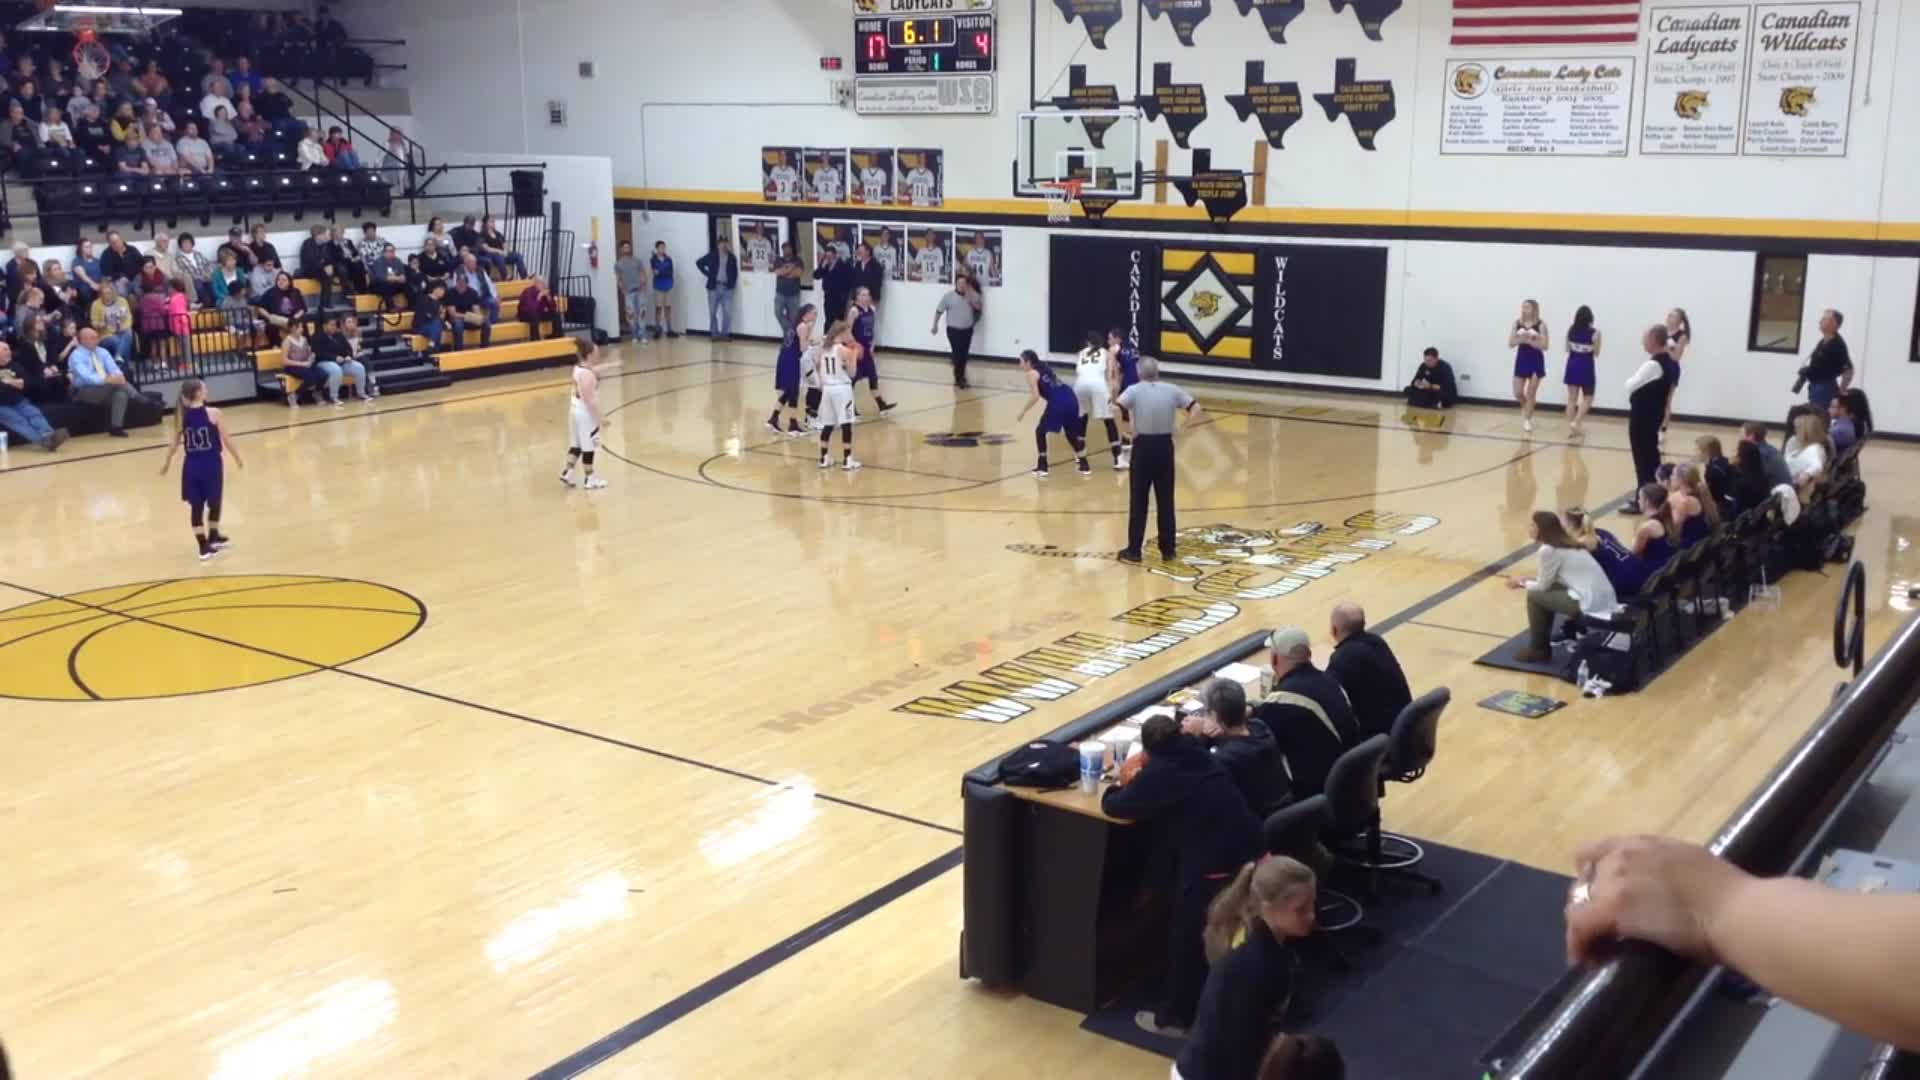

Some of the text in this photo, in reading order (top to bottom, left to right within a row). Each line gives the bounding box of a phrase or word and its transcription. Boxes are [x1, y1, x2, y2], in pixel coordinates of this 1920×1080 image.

[857, 21, 882, 32] HOME
[957, 17, 991, 28] VISITOR
[1657, 12, 1741, 32] Canadian
[1761, 9, 1850, 30] Canadian
[869, 36, 886, 58] 17
[975, 33, 988, 56] 4
[1654, 34, 1738, 60] Ladycats
[1761, 32, 1848, 52] Wildcats
[933, 51, 940, 71] 1
[1272, 256, 1289, 360] WILDCATS
[825, 356, 837, 375] 11
[185, 426, 213, 452] 11
